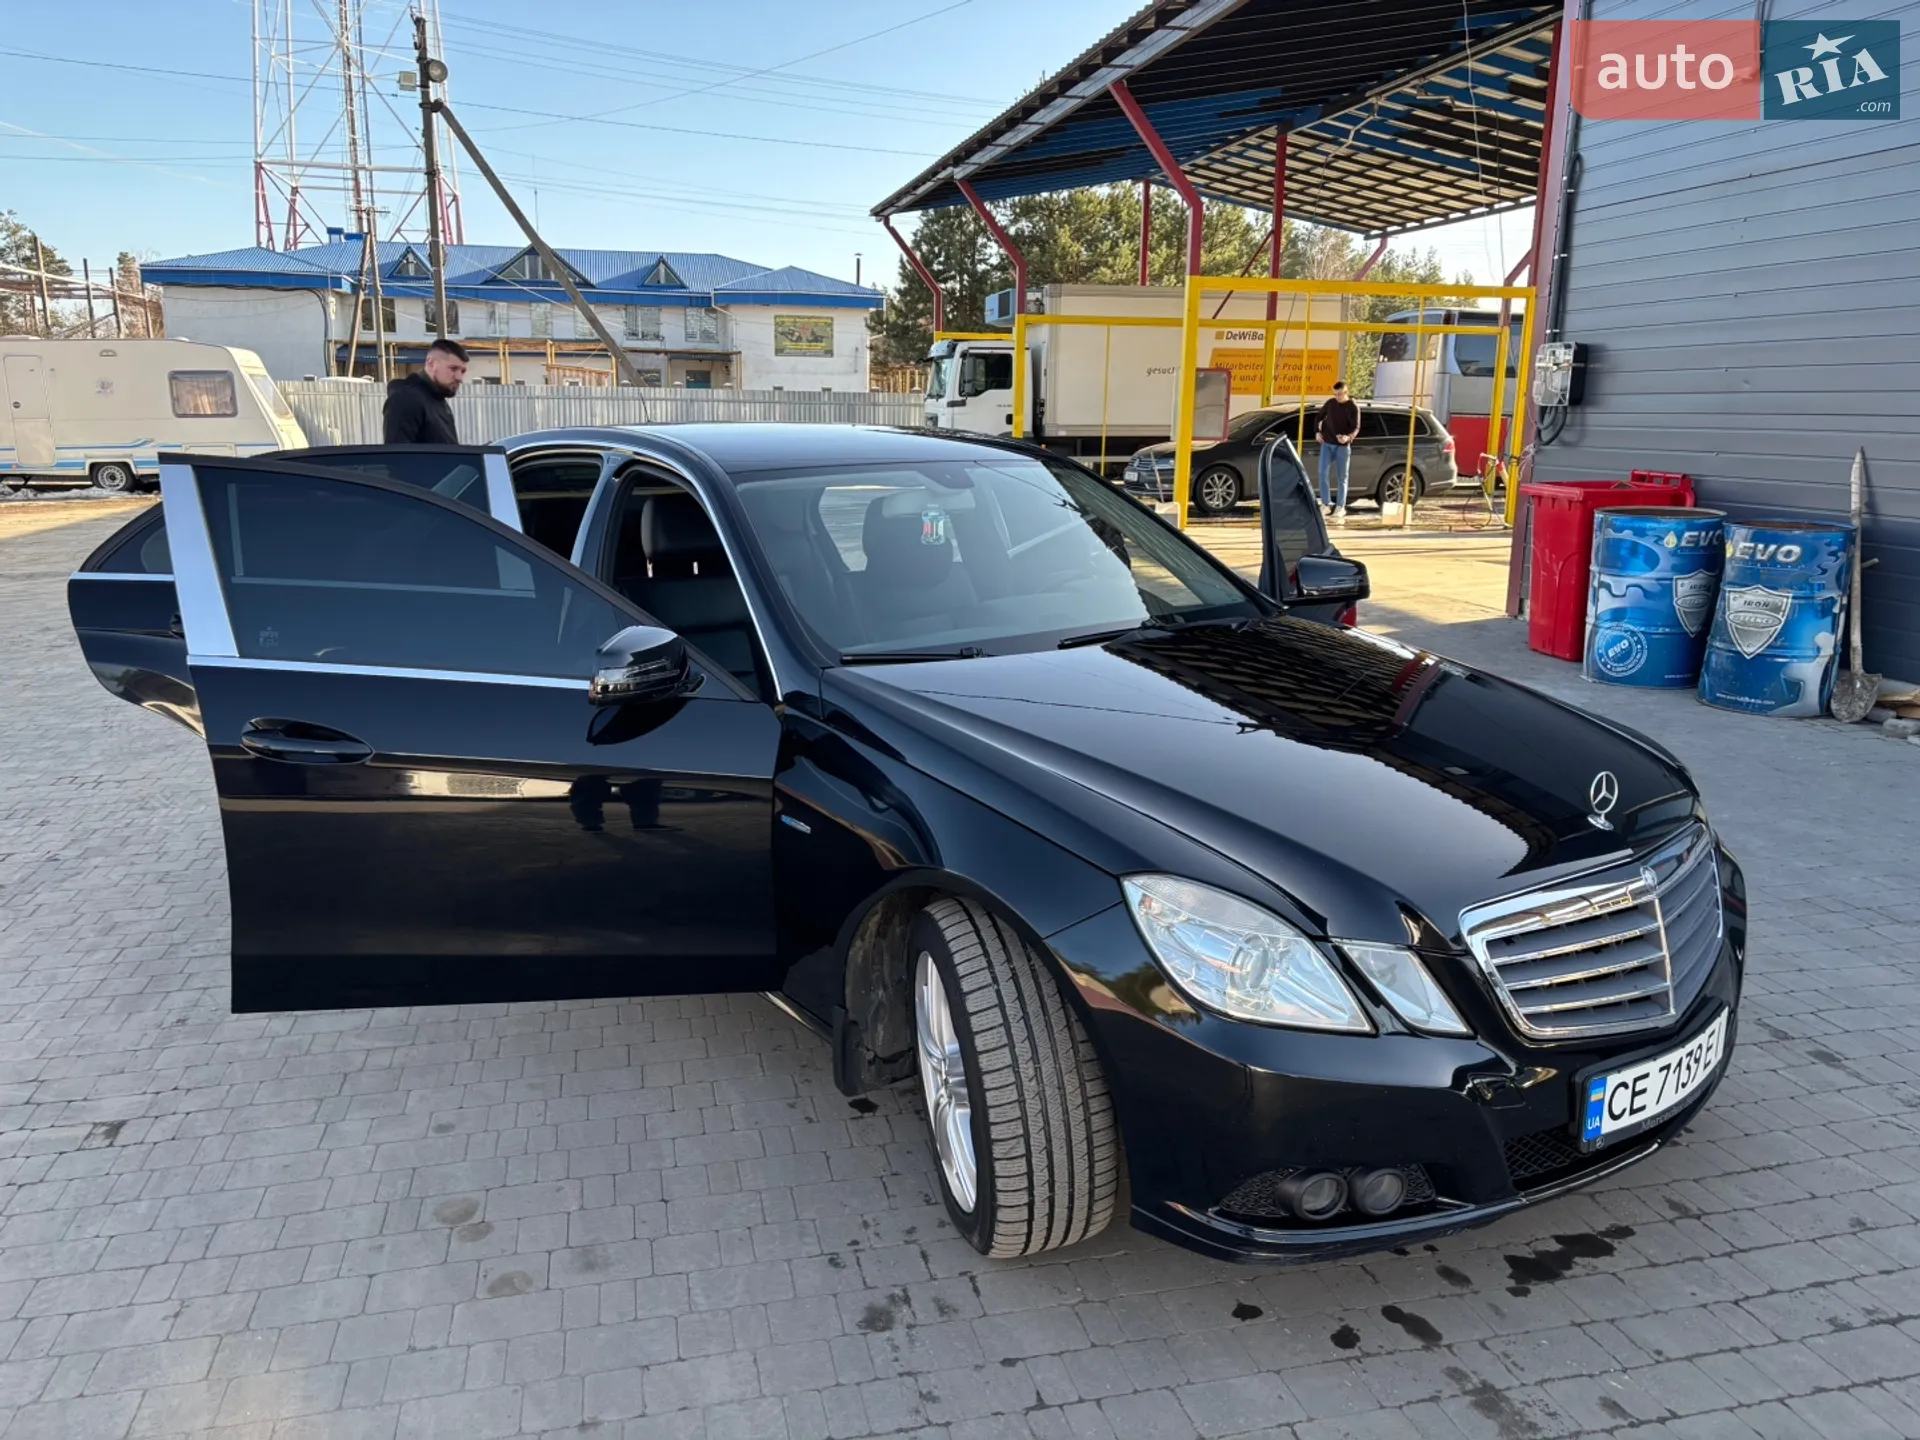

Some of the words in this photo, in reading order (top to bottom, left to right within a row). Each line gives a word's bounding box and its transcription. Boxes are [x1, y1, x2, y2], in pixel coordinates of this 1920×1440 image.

[1225, 330, 1264, 341] DeWiBa
[1283, 362, 1333, 372] Prodktion,
[1735, 541, 1801, 563] EVO
[1743, 599, 1771, 608] IRON
[1608, 639, 1630, 658] EVO
[1608, 1071, 1650, 1121] CE
[1656, 1042, 1703, 1106] 7139
[1587, 1115, 1600, 1130] UA
